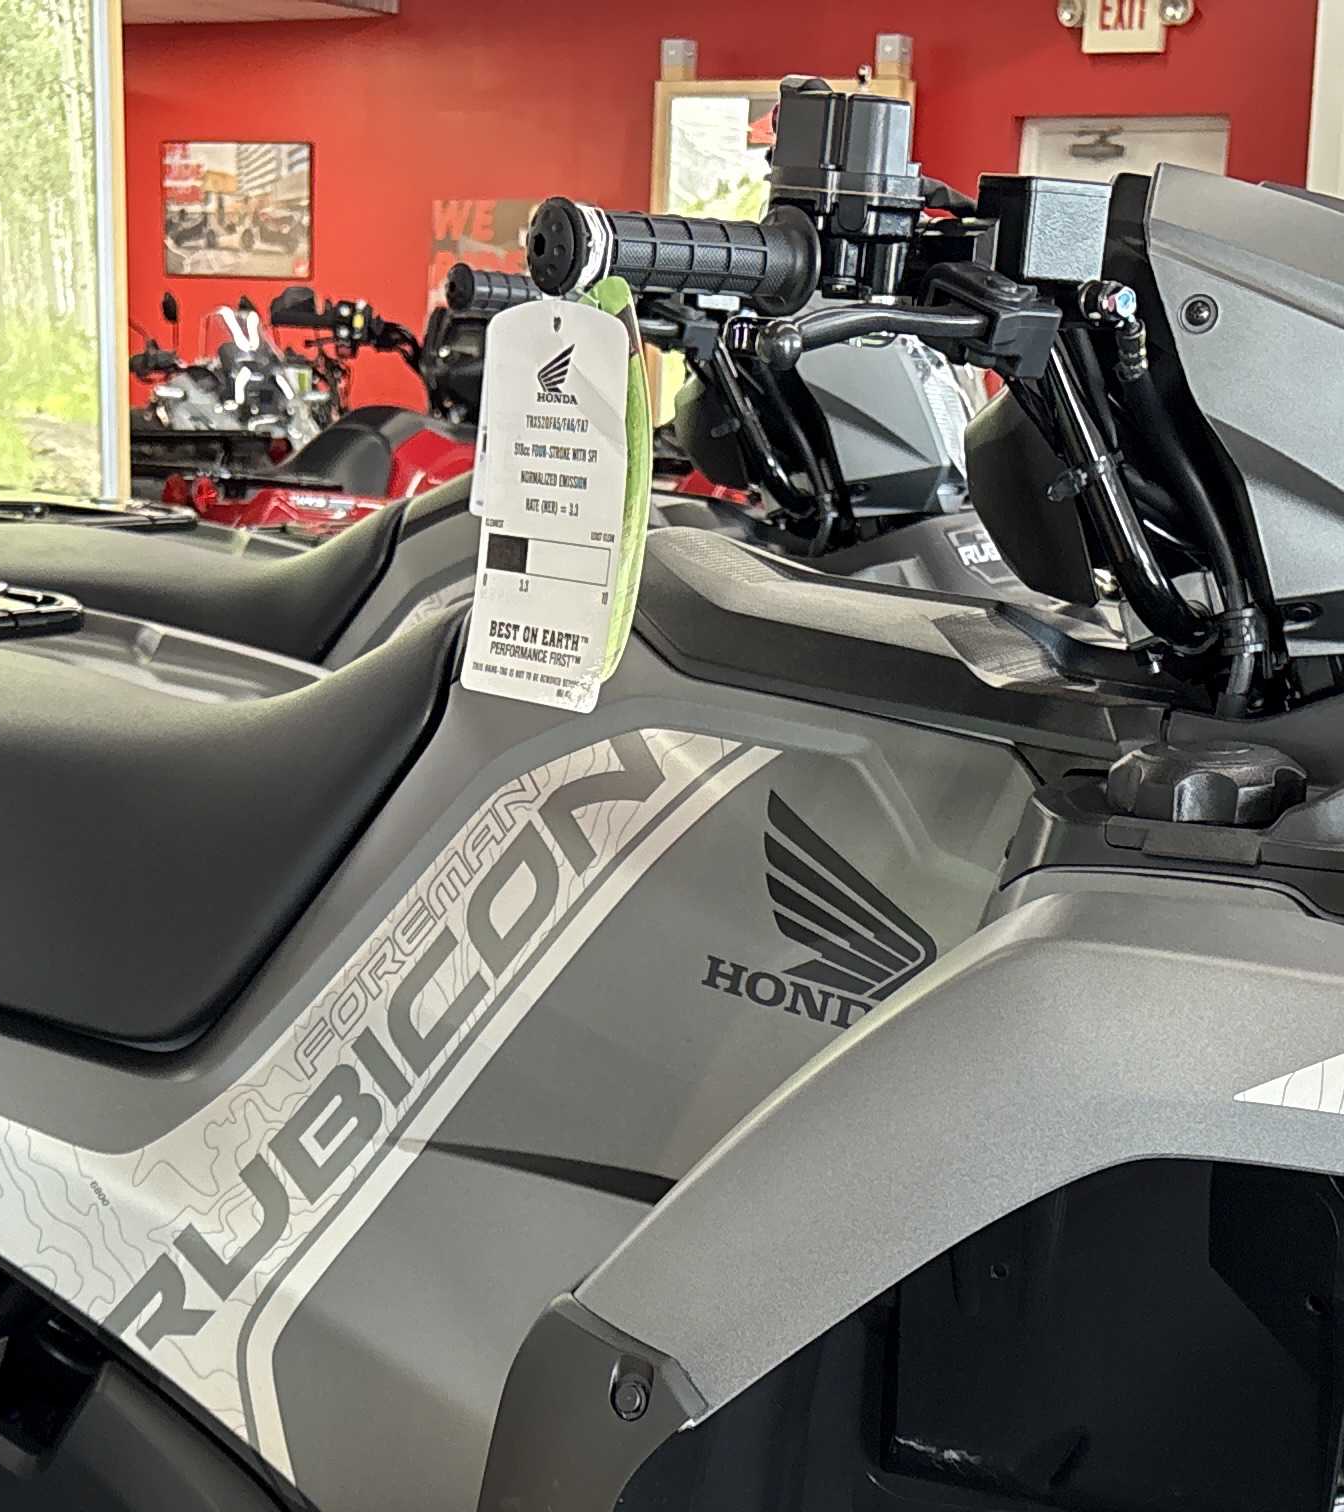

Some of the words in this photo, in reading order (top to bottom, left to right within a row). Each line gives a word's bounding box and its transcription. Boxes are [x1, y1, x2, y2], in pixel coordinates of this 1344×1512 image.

[432, 199, 497, 241] WE
[537, 392, 578, 405] HONDA
[526, 498, 539, 512] RATE
[489, 620, 520, 641] BEST
[523, 626, 539, 644] ON
[489, 641, 548, 664] PERFORMANCE
[294, 771, 540, 1080] FOREMAN
[701, 955, 874, 1029] HOND
[102, 730, 666, 1351] RUBICON
[90, 1180, 110, 1207] 6800
